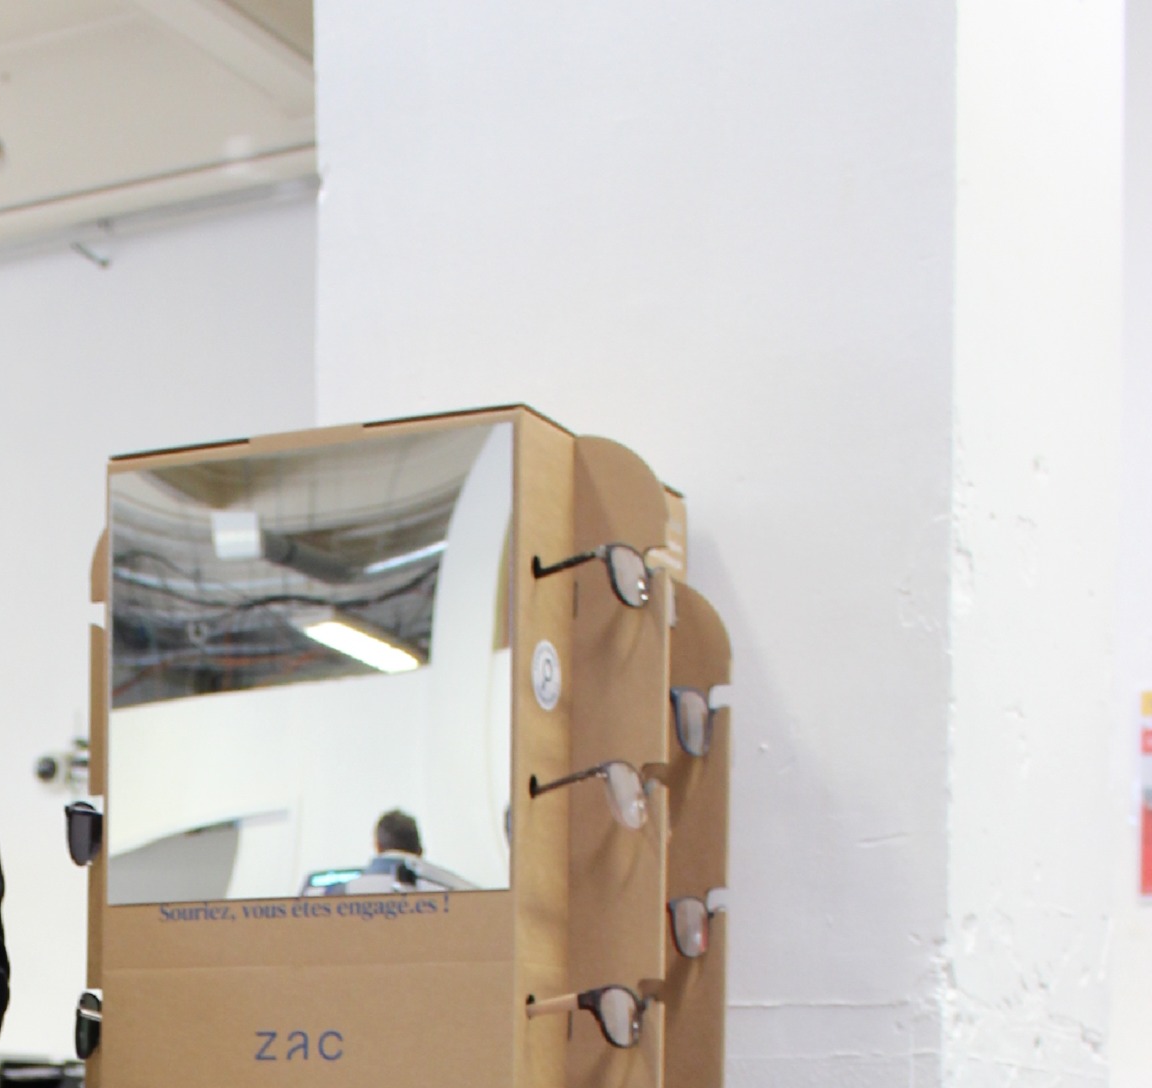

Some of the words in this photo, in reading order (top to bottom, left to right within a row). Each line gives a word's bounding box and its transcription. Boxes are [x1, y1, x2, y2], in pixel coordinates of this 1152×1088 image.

[159, 903, 237, 922] Souriez,
[242, 902, 286, 919] vous
[255, 1030, 343, 1061] zac
